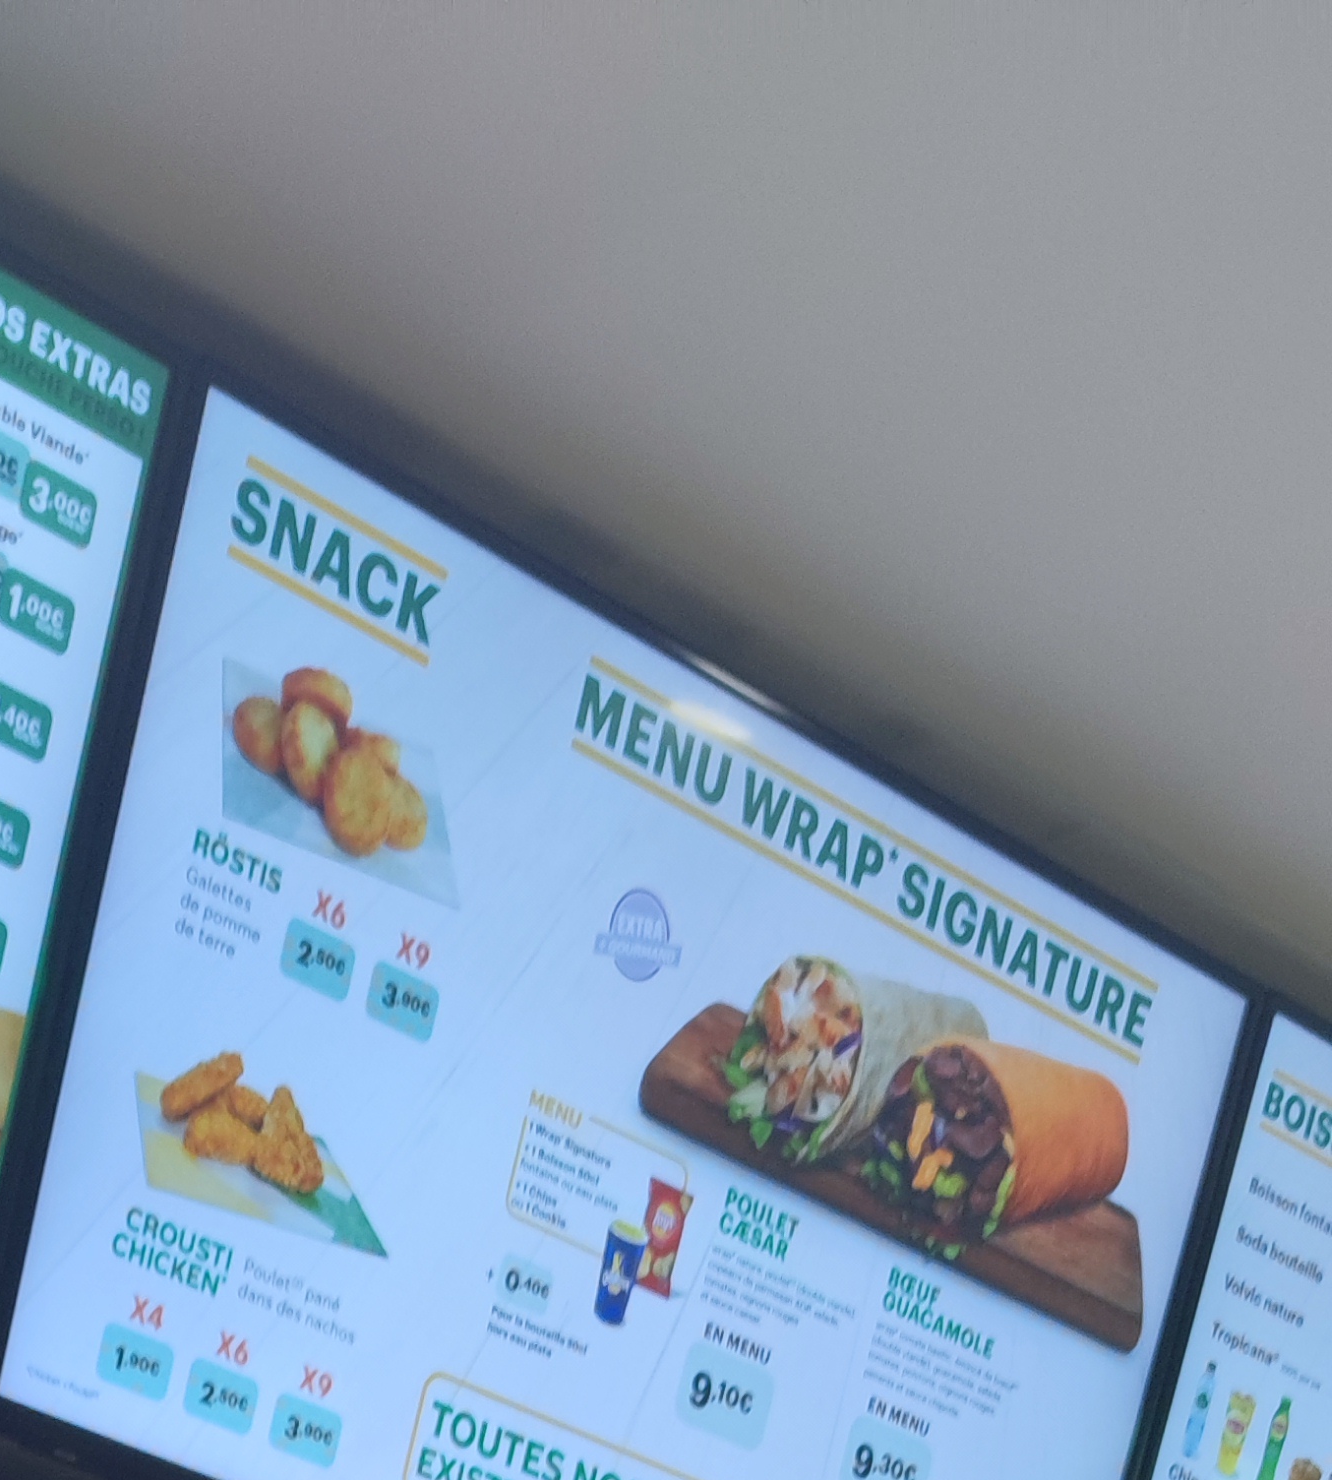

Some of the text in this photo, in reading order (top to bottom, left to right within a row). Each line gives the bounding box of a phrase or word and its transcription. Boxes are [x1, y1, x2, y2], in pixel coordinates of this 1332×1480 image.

[29, 319, 153, 416] EXTRAS
[229, 477, 442, 648] SNACK
[192, 827, 283, 895] RÖSTIS
[575, 673, 733, 806] MENU
[897, 862, 1154, 1049] SIGNATURE
[185, 866, 252, 913] Galettes
[174, 918, 236, 959] de terre
[179, 893, 261, 945] de pomme
[312, 888, 432, 970] X6 X9
[529, 1089, 582, 1130] MENU
[726, 1187, 799, 1240] POULET
[1249, 1177, 1297, 1216] Boisson
[126, 1206, 235, 1272] CROUSTI
[719, 1212, 789, 1262] CÆSAR
[1236, 1225, 1323, 1284] Soda bouteille
[237, 1284, 356, 1347] dans des nachos
[304, 1287, 341, 1313] pané
[882, 1291, 995, 1360] GUACAMOLE
[1225, 1272, 1305, 1328] Volvic nature
[129, 1295, 334, 1398] X4 X6 X9
[704, 1321, 771, 1365] EN MENU
[867, 1397, 930, 1437] EN MENU
